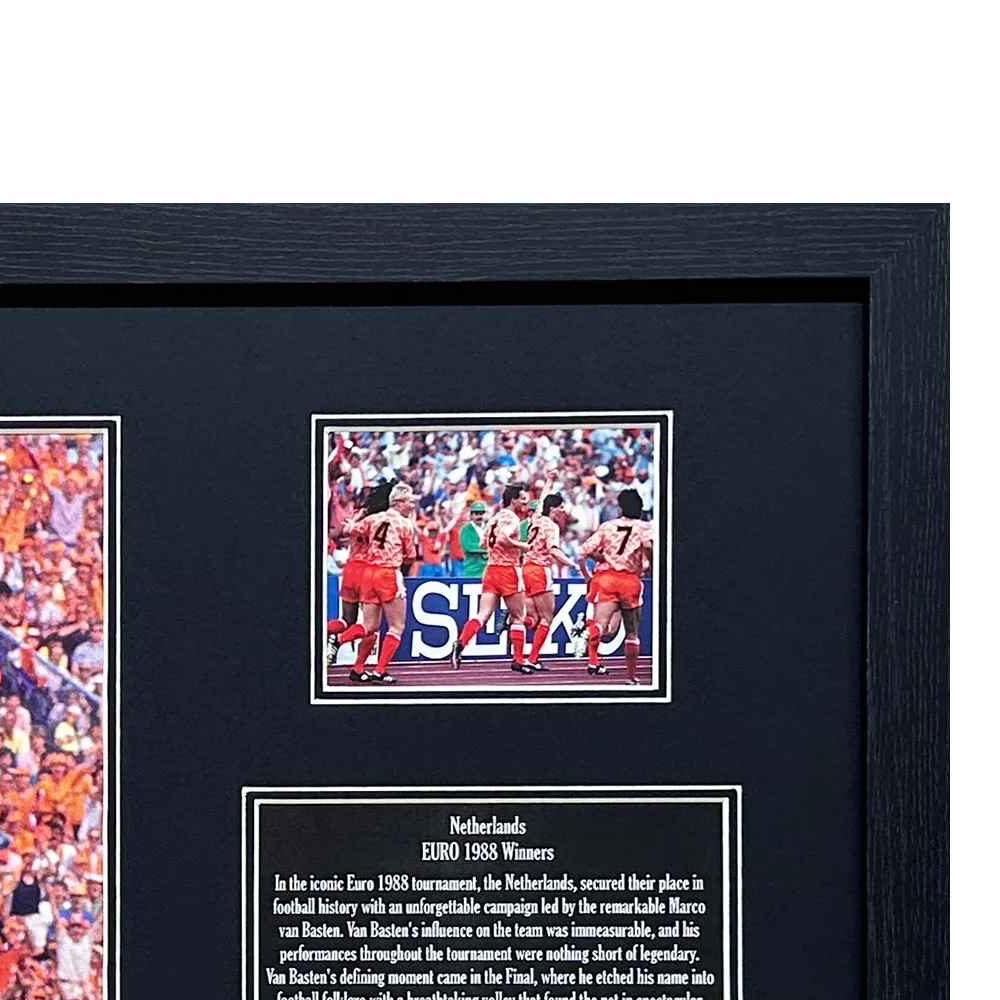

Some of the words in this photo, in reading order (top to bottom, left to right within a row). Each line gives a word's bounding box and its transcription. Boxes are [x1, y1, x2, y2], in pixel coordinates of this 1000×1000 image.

[373, 521, 391, 550] 4
[616, 525, 633, 556] 7
[449, 816, 527, 835] Netherlands
[422, 842, 460, 860] EURO
[464, 843, 498, 860] 1988
[501, 842, 555, 860] Winners
[275, 874, 287, 891] In
[289, 874, 307, 891] the
[310, 875, 344, 891] iconic
[347, 874, 374, 891] Euro
[378, 874, 409, 891] 1988
[412, 876, 481, 893] tournament,
[483, 874, 502, 890] the
[505, 874, 578, 892] Netherlands,
[580, 874, 625, 891] secured
[628, 873, 656, 890] their
[659, 873, 690, 893] place
[692, 874, 704, 890] in
[273, 898, 316, 914] football
[318, 897, 359, 917] history
[361, 897, 386, 914] with
[388, 903, 403, 914] an
[405, 897, 481, 917] unforgettable
[483, 898, 539, 917] campaign
[541, 897, 559, 914] led
[561, 897, 576, 917] by
[578, 897, 598, 914] the
[599, 897, 666, 914] remarkable
[668, 897, 706, 914] Marco
[278, 927, 300, 937] van
[302, 921, 344, 938] Basten.
[346, 921, 368, 937] Van
[370, 921, 419, 937] Basten's
[421, 921, 473, 937] influence
[475, 927, 491, 937] on
[493, 921, 512, 937] the
[514, 923, 543, 937] team
[546, 926, 569, 937] was
[571, 921, 656, 940] immeasurable,
[658, 921, 680, 937] and
[682, 920, 700, 937] his
[279, 944, 357, 964] performances
[360, 944, 423, 964] throughout
[425, 944, 444, 961] the
[446, 947, 513, 961] tournament
[515, 950, 543, 961] were
[546, 944, 590, 964] nothing
[591, 944, 623, 961] short
[625, 944, 639, 961] of
[640, 944, 700, 964] legendary.
[265, 968, 286, 984] Van
[289, 968, 337, 984] Basten's
[339, 968, 385, 987] defining
[388, 970, 434, 984] moment
[437, 974, 467, 984] came
[470, 968, 482, 984] in
[484, 968, 503, 984] the
[505, 968, 538, 986] Final,
[540, 968, 576, 984] where
[578, 968, 593, 984] he
[596, 967, 634, 984] etched
[636, 968, 655, 984] his
[657, 974, 689, 984] name
[691, 969, 715, 985] into
